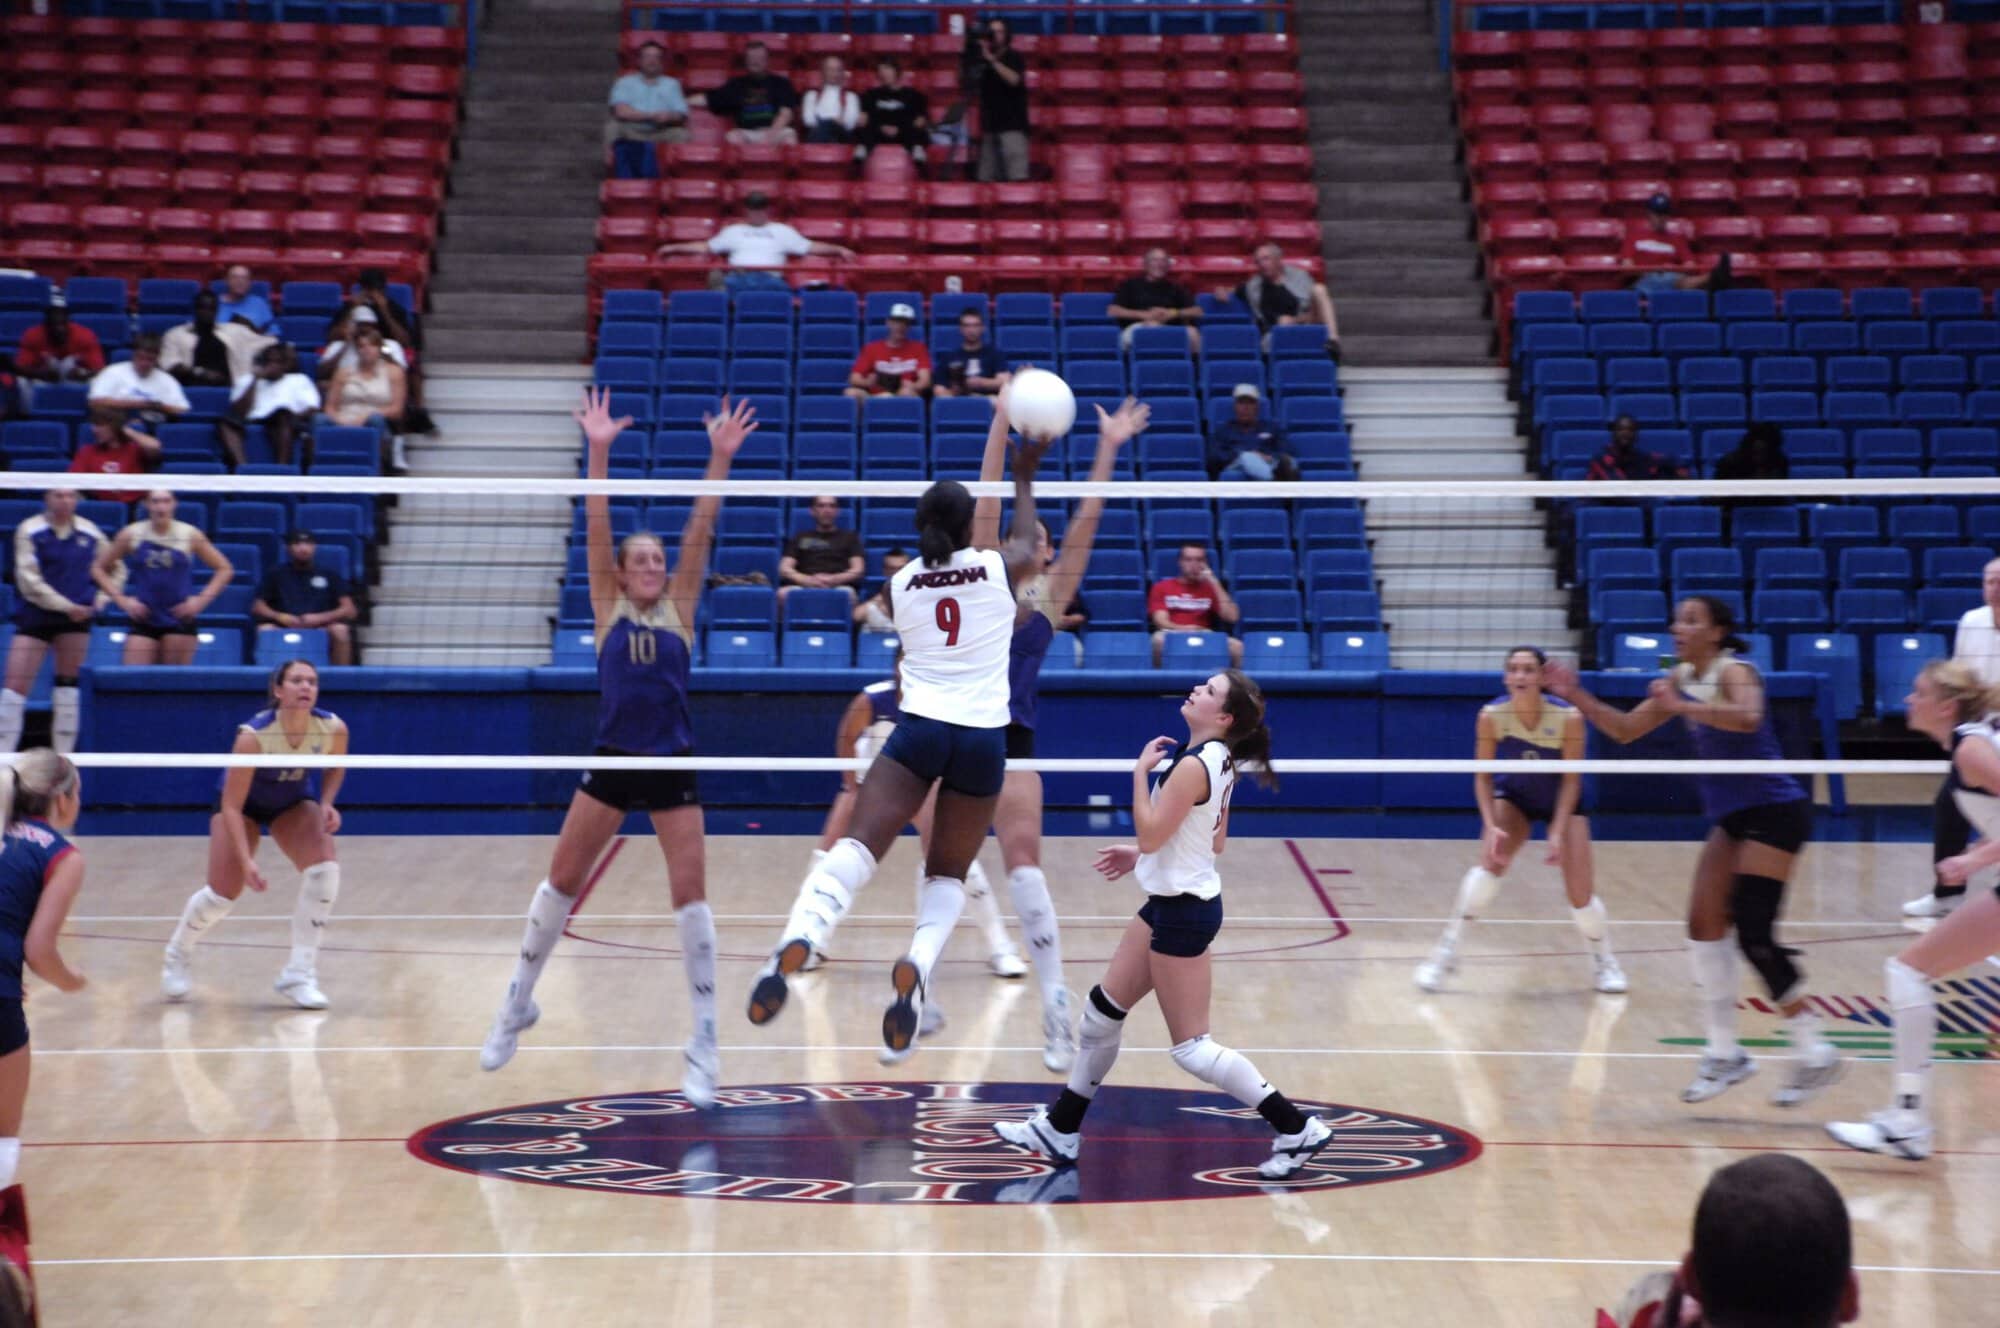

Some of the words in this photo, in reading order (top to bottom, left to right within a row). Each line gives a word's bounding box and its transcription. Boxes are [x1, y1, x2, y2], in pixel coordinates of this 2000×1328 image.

[905, 565, 989, 591] ARIZONA
[935, 597, 961, 647] 9
[627, 631, 657, 665] 10
[468, 1083, 980, 1131] BOBBI
[441, 1131, 588, 1155] &
[498, 1158, 980, 1202] LUTE
